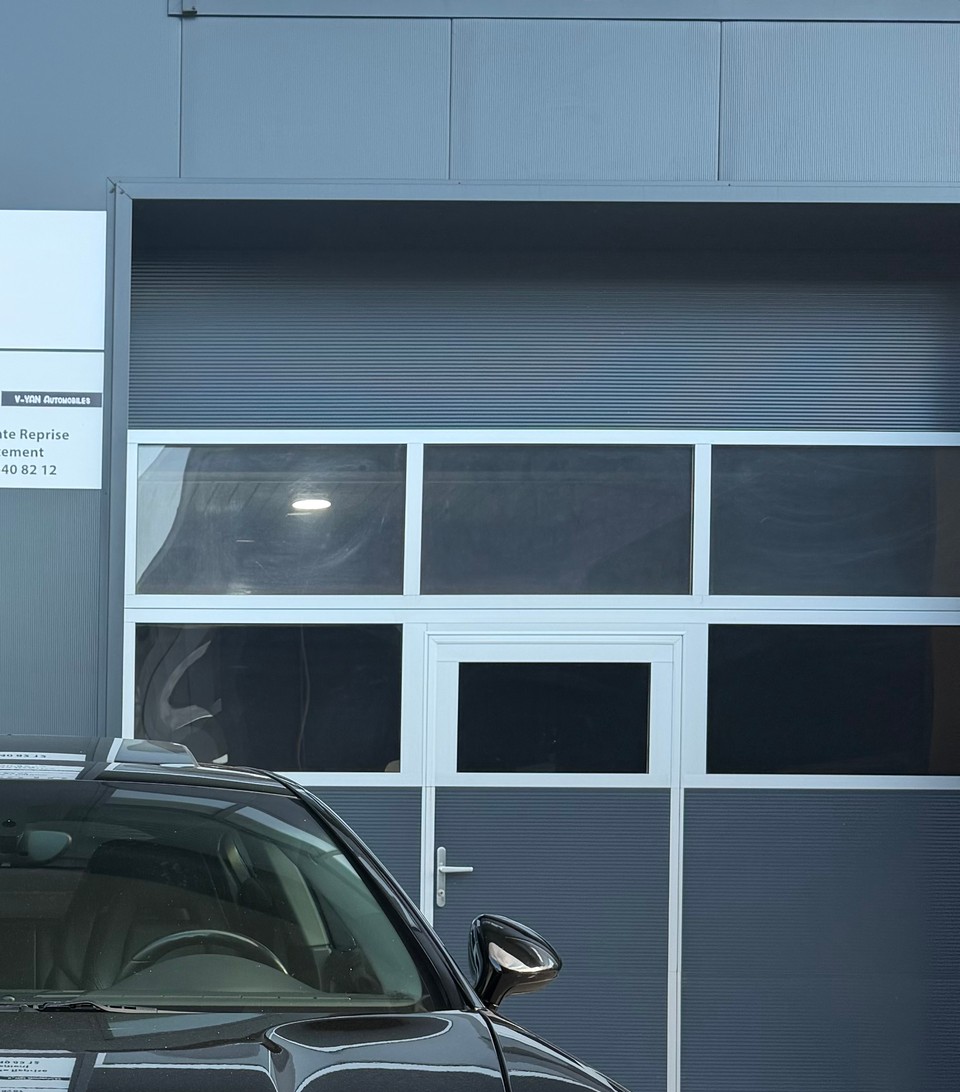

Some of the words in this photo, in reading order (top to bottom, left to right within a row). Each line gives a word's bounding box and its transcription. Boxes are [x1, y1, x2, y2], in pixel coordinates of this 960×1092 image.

[14, 395, 42, 404] V-YAN
[20, 429, 70, 442] Reprise
[21, 464, 37, 475] 82
[41, 465, 57, 476] 12
